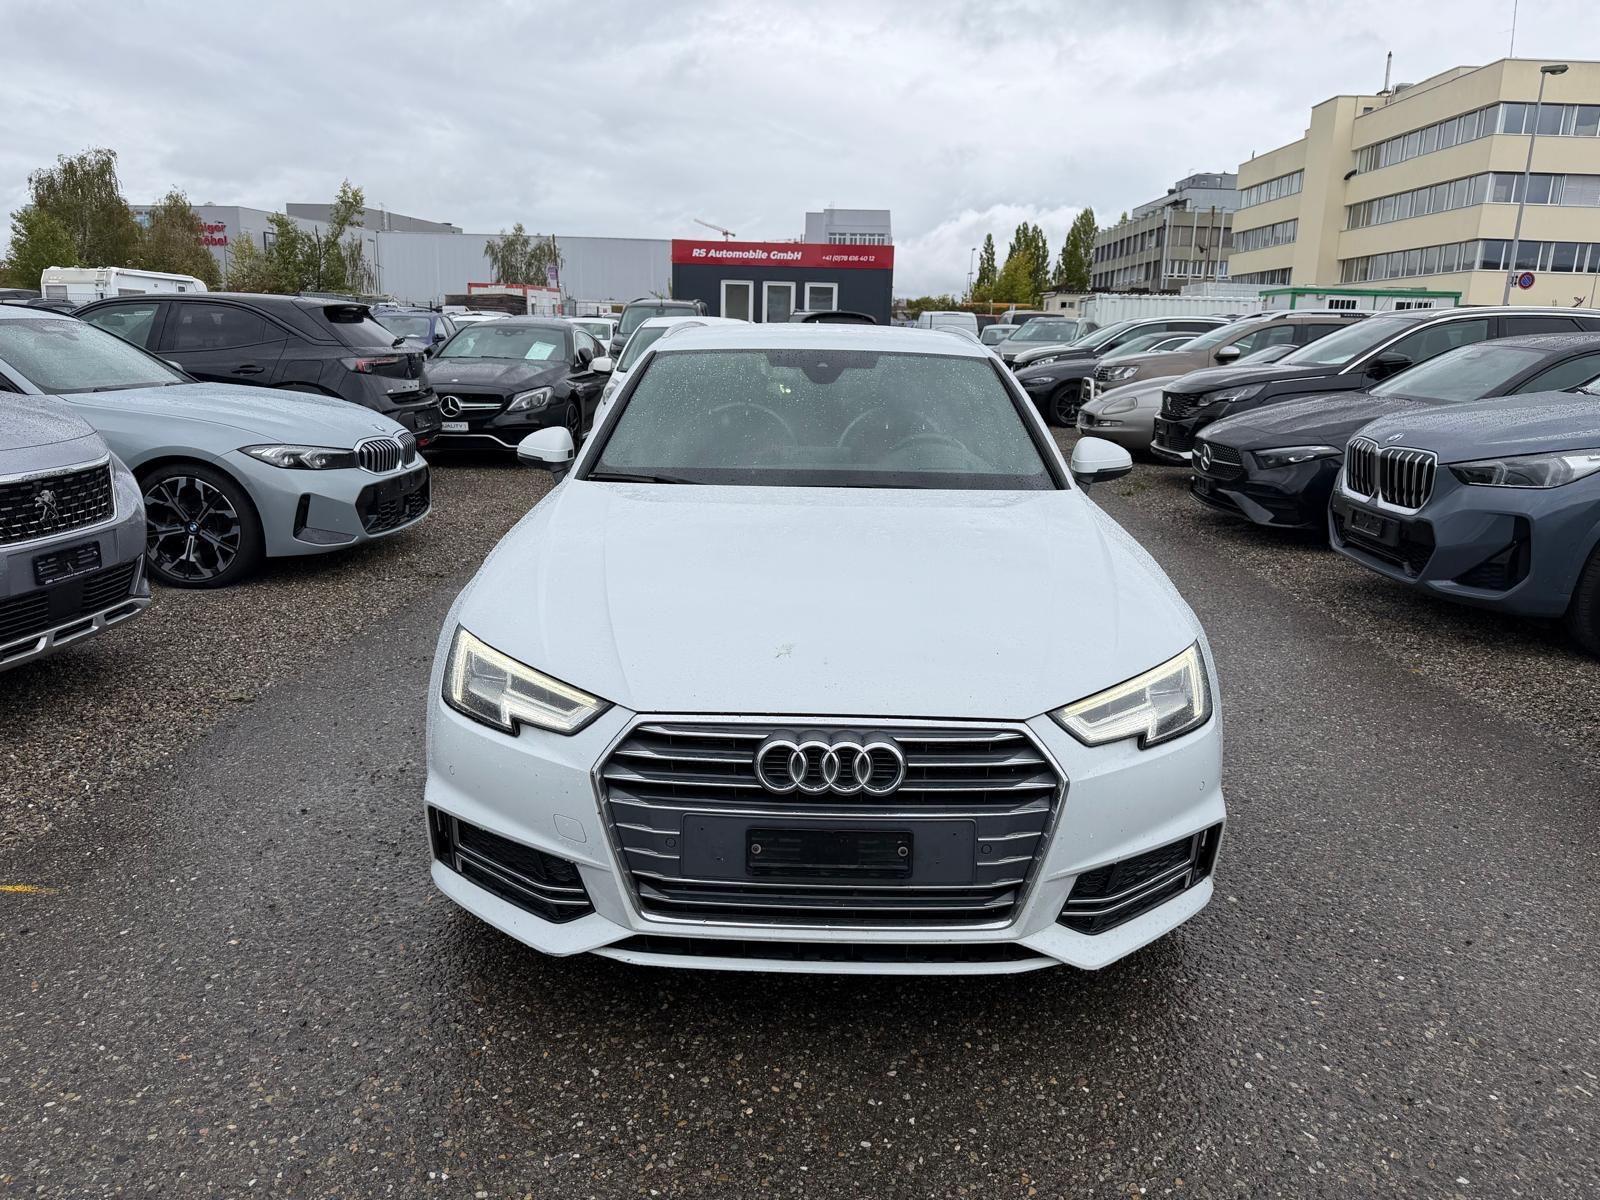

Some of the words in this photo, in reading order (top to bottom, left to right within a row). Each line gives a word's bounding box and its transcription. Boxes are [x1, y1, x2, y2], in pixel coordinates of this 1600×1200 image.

[692, 248, 706, 257] RS
[707, 249, 768, 259] Automobile
[770, 251, 802, 260] GmbH
